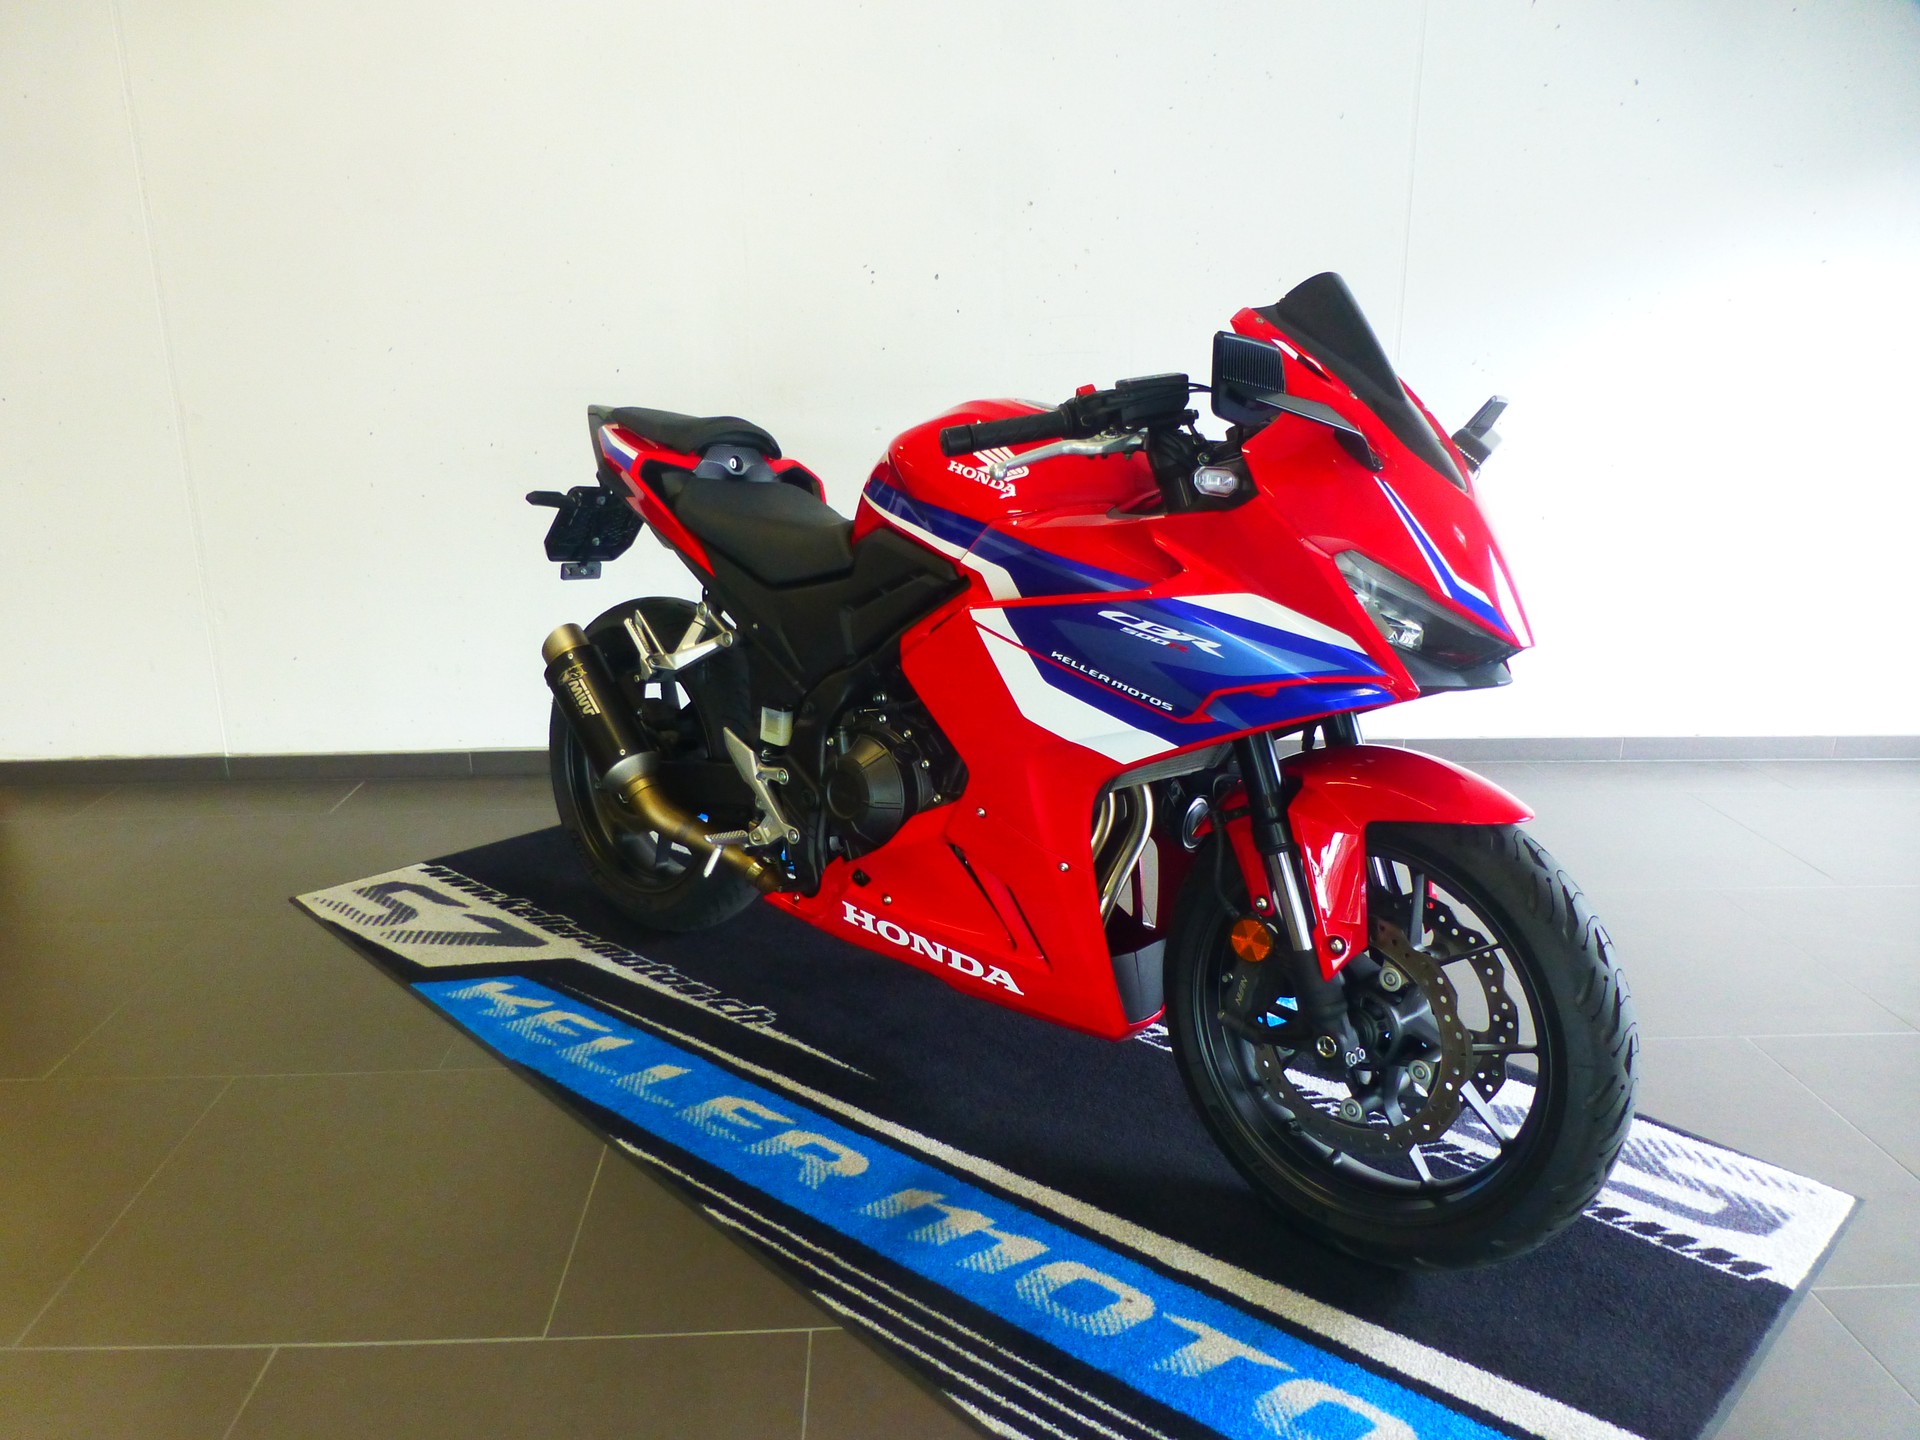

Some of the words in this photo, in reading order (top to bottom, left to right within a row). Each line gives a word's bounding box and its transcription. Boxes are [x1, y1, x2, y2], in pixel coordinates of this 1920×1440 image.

[947, 460, 1016, 499] HONDA
[1097, 610, 1225, 659] CBR
[1120, 626, 1189, 653] 500R
[1051, 651, 1110, 683] KELLER
[1111, 680, 1174, 712] MOTOS
[842, 900, 1025, 996] HONDA
[437, 980, 870, 1190] KELLER
